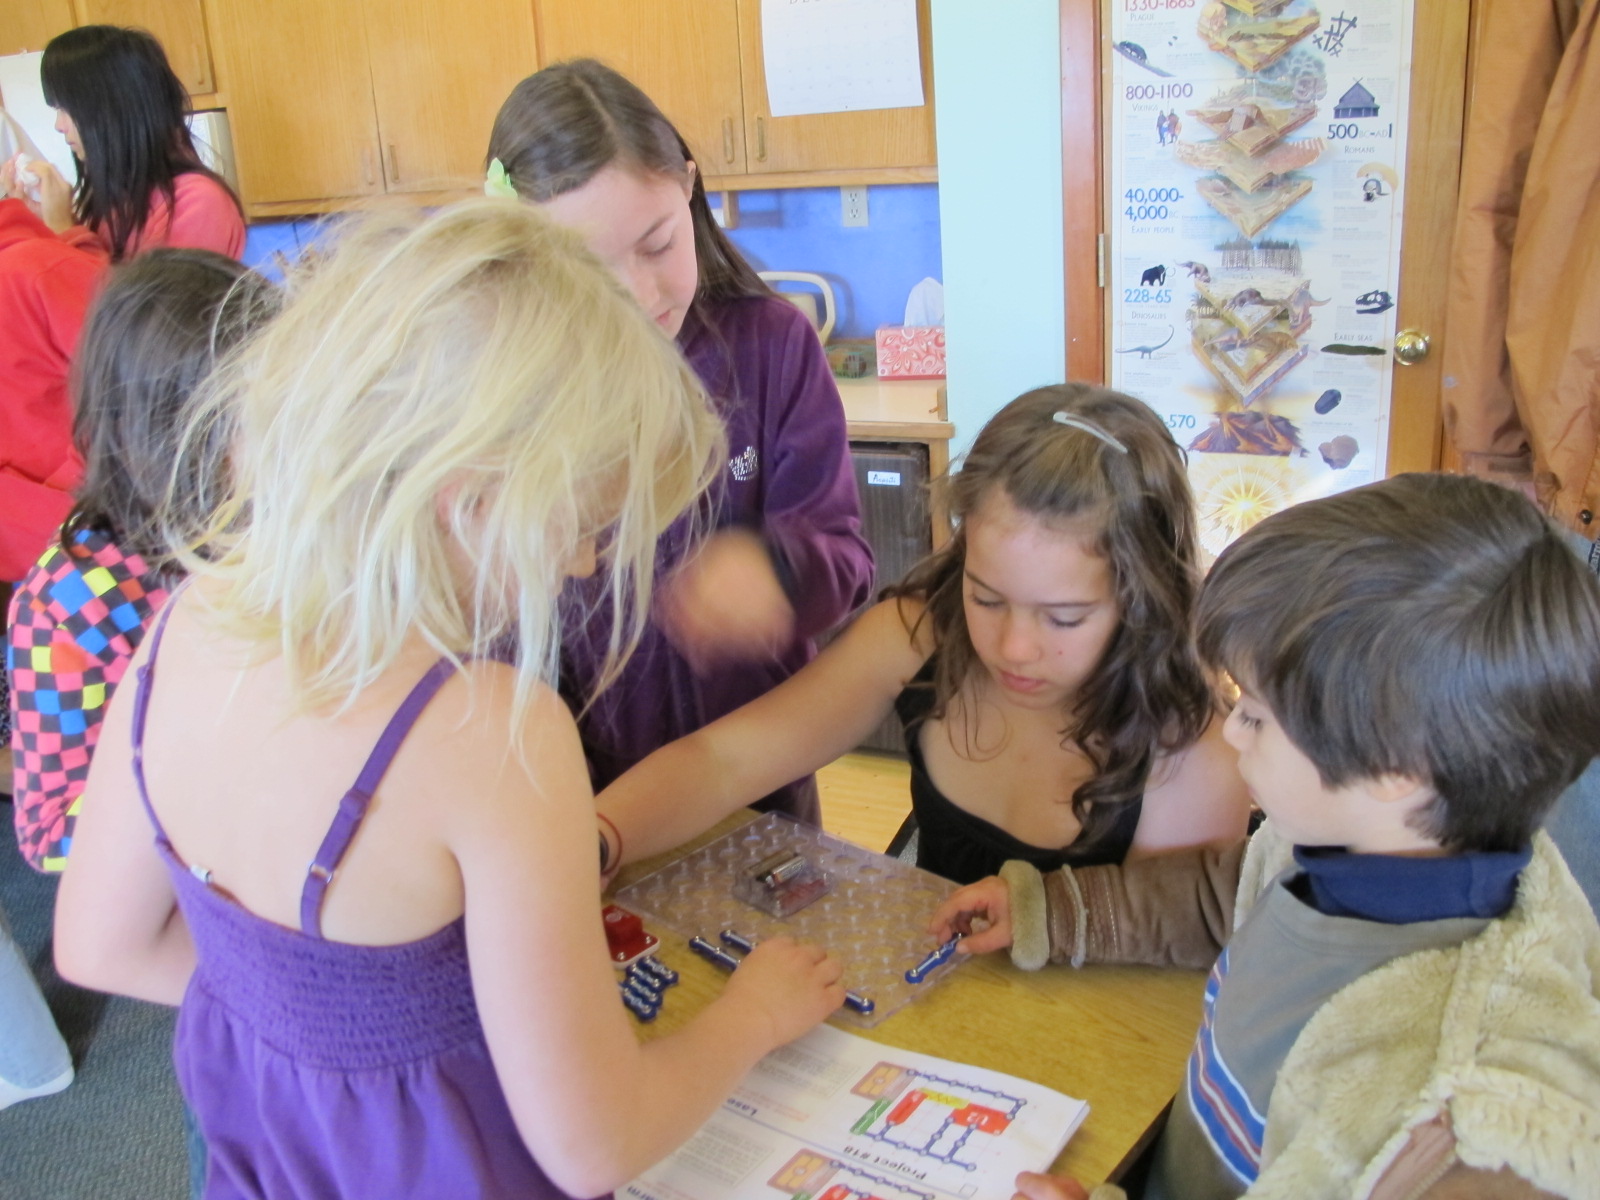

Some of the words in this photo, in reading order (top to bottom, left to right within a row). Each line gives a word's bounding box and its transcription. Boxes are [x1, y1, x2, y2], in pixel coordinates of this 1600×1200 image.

[1125, 83, 1193, 100] 800-1100
[1124, 187, 1184, 204] 40,000-
[1124, 205, 1168, 222] 4,000
[1124, 288, 1172, 304] 228-65
[1158, 414, 1197, 429] -570
[873, 1156, 927, 1180] Project
